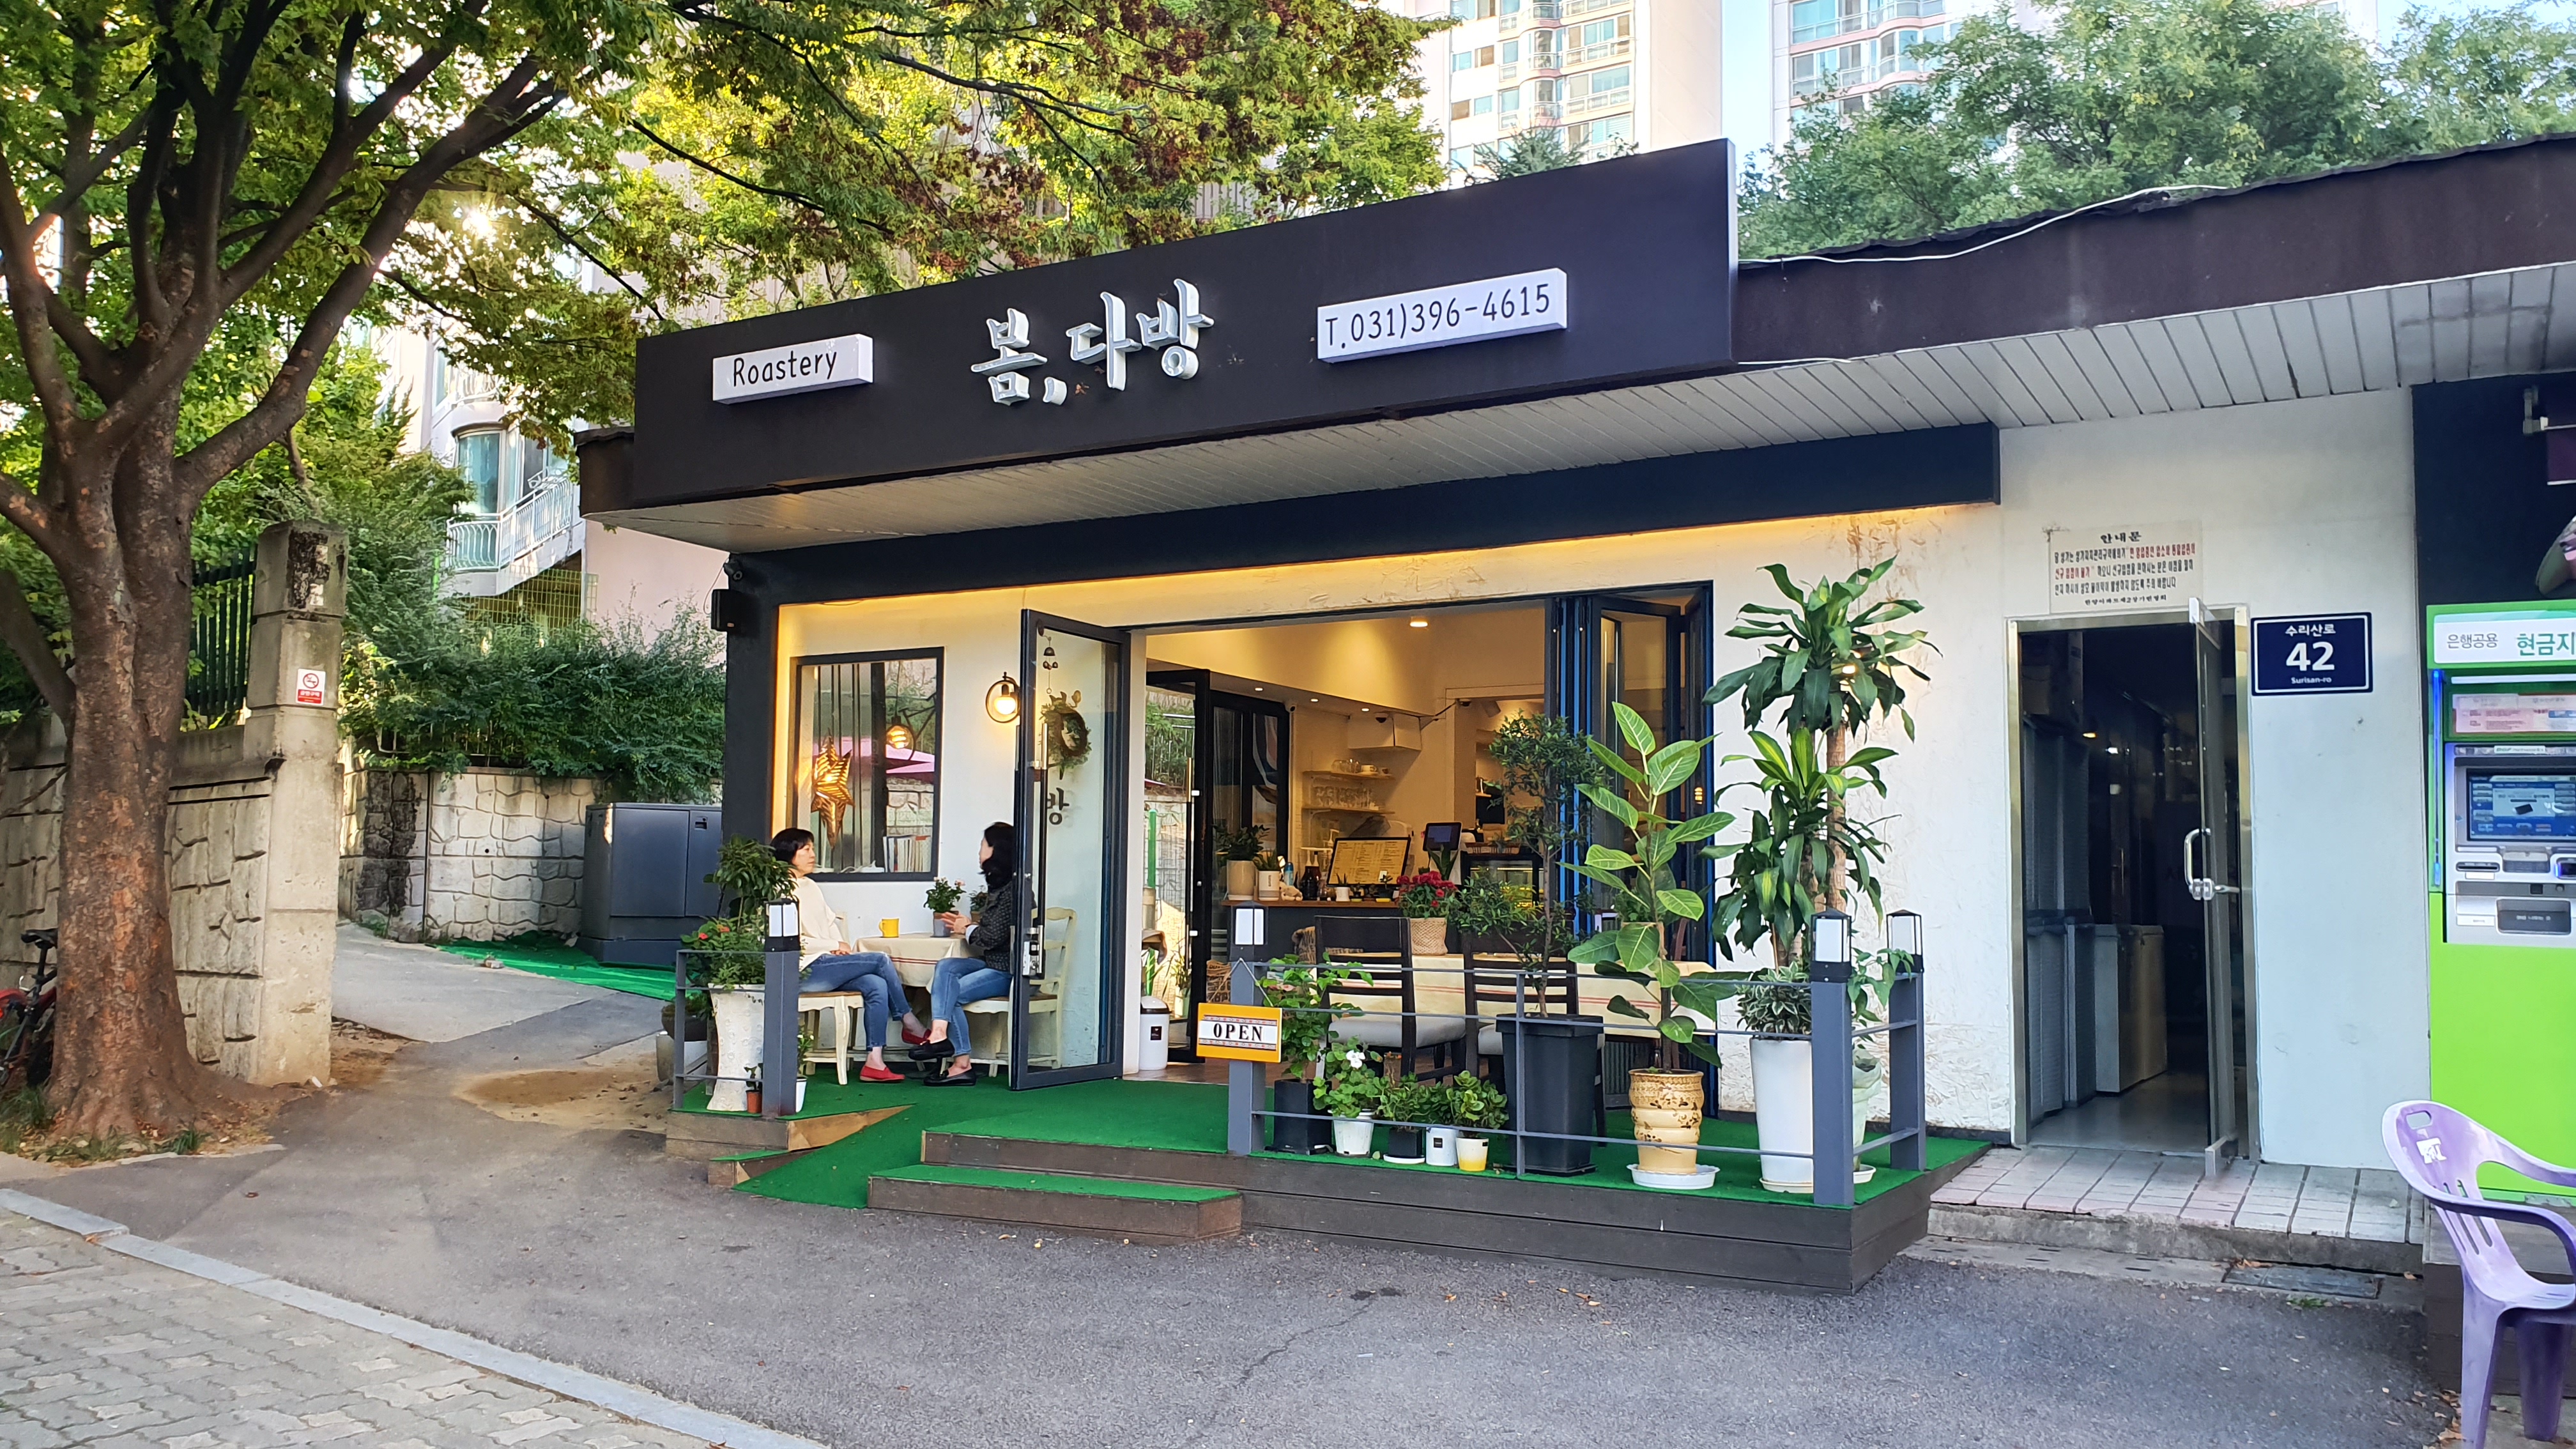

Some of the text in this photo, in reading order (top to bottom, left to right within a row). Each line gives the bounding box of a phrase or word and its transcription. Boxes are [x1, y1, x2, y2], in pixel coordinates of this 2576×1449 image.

[1325, 283, 1550, 349] T.031)396-4615
[733, 350, 837, 387] Roastery
[2100, 531, 2142, 544] 안내문
[2284, 624, 2337, 636] 수리산로
[2446, 632, 2499, 649] 은행공용
[2285, 641, 2336, 672] 42
[2290, 675, 2332, 685] Surisan-ro
[1213, 1023, 1263, 1042] OPEN
